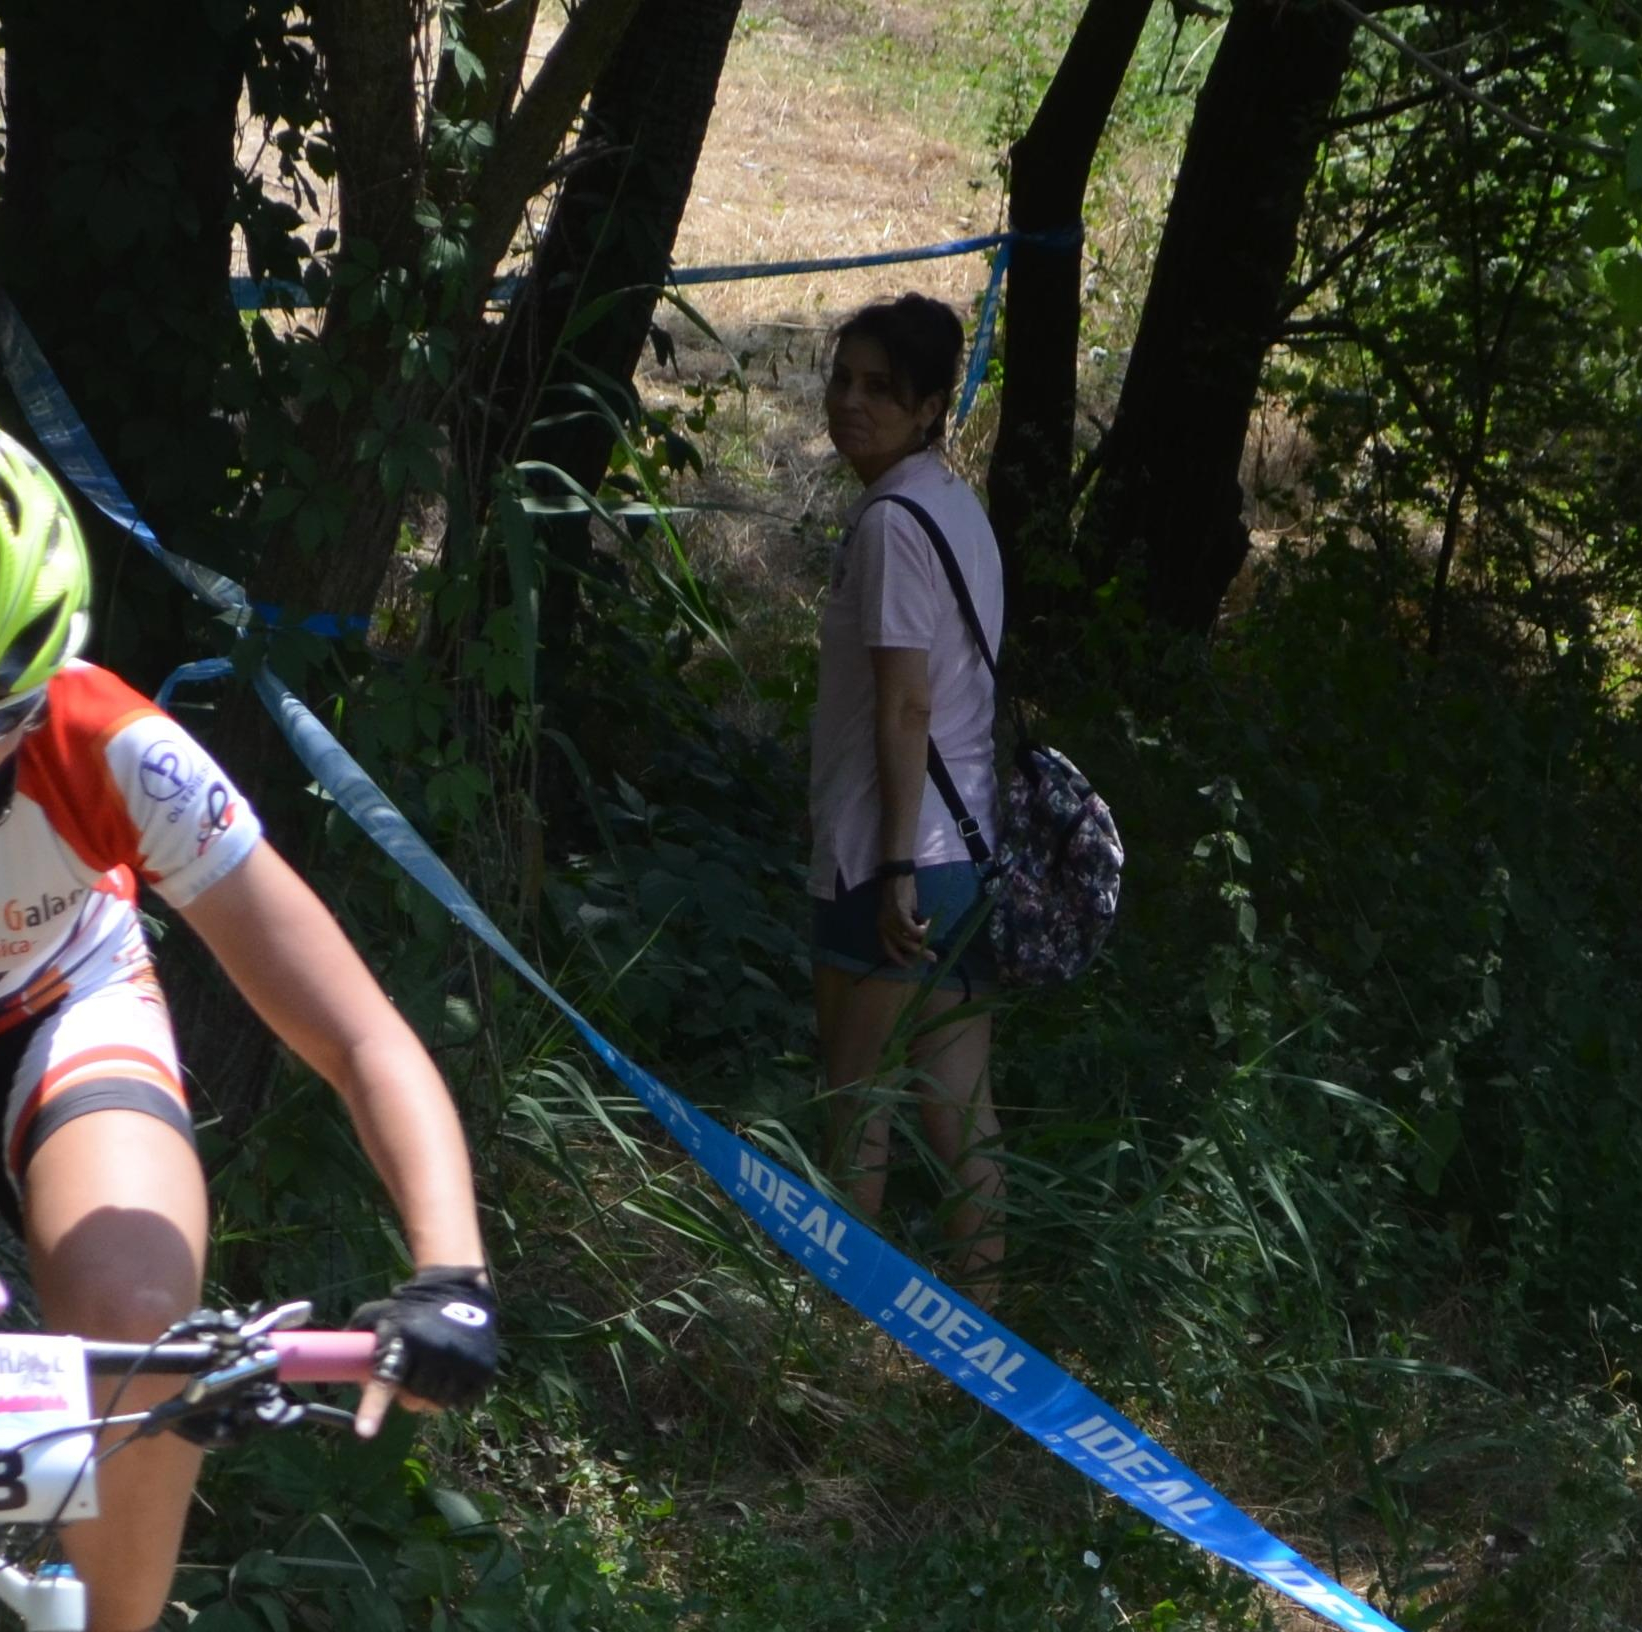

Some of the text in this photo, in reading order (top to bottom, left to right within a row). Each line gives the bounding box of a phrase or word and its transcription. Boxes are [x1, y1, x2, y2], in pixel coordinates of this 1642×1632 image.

[735, 1183, 842, 1280] BIKES
[739, 1149, 849, 1266] IDEAL
[879, 1308, 1004, 1401] BIKES
[893, 1276, 1027, 1393] IDEAL
[1064, 1414, 1214, 1525] IDEAL
